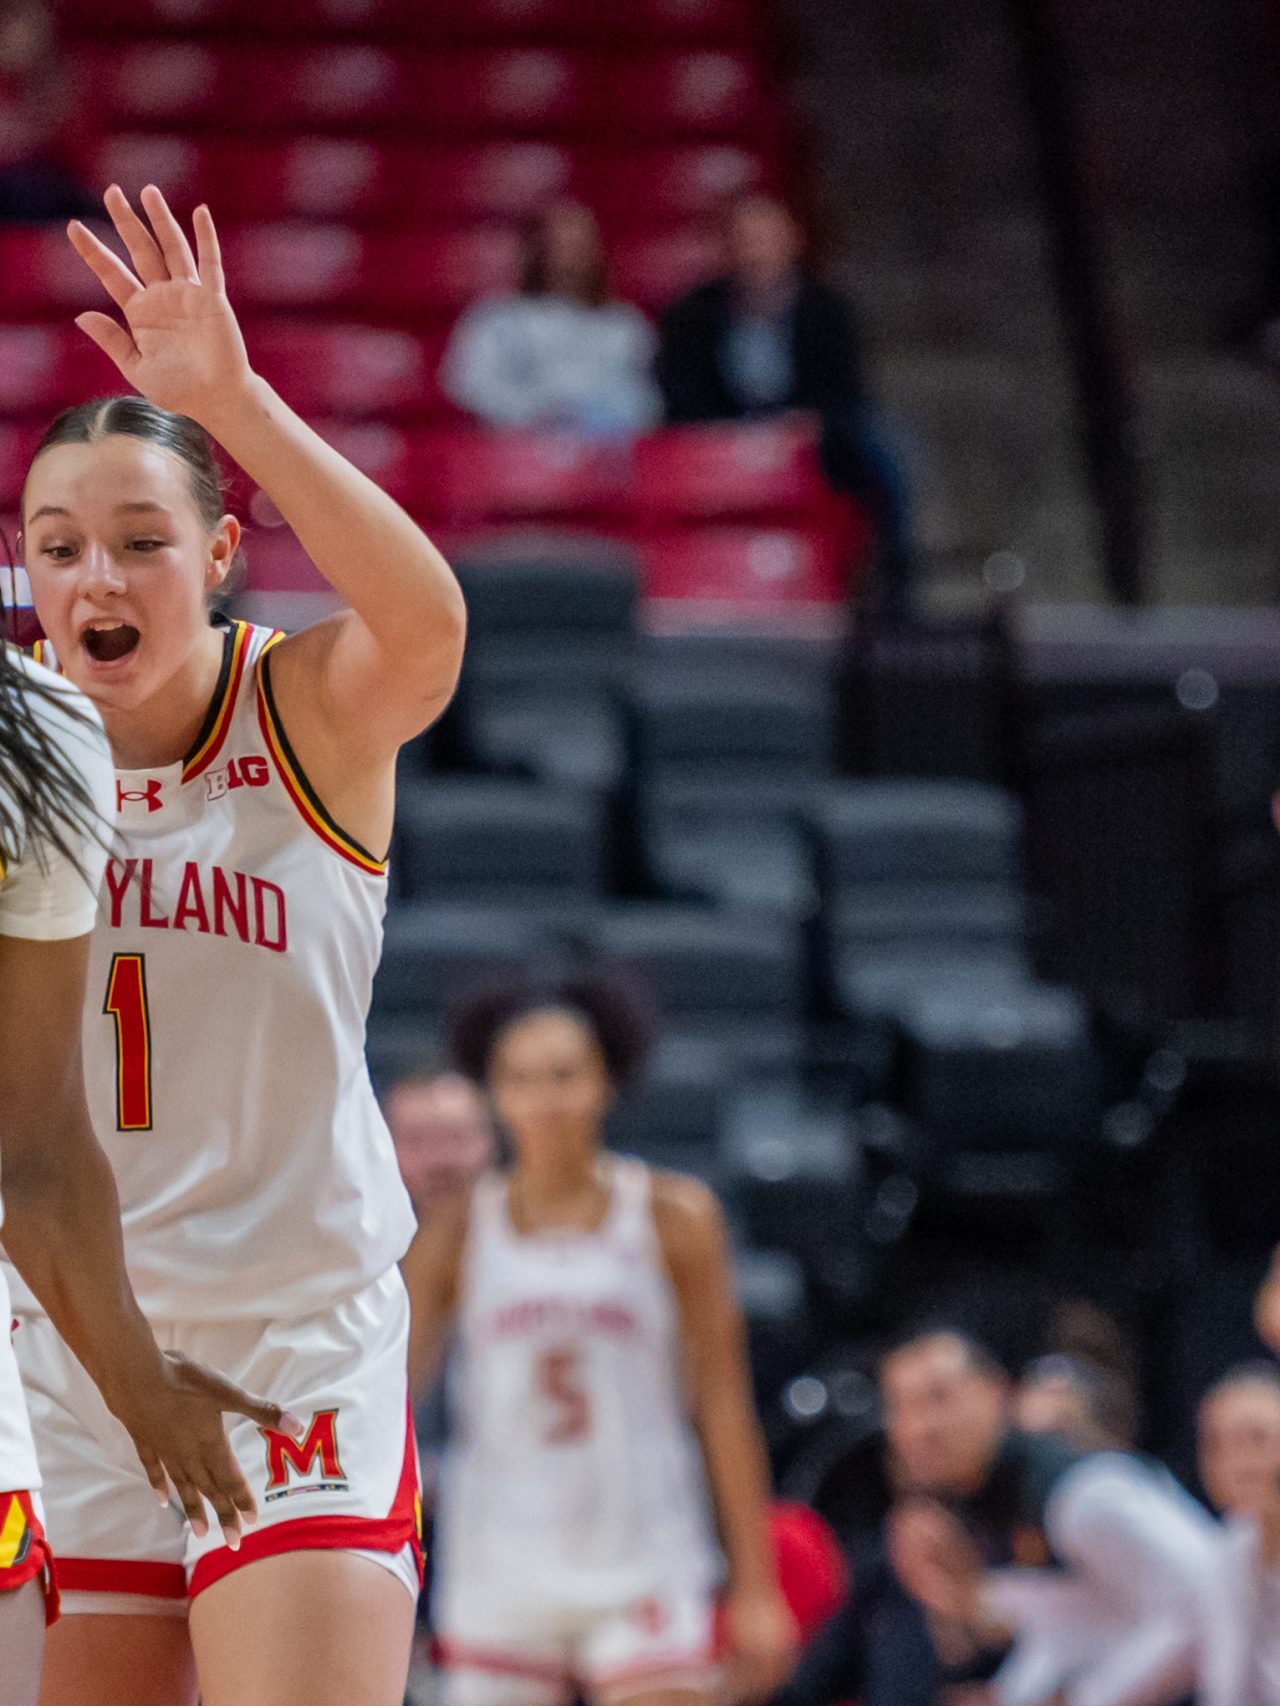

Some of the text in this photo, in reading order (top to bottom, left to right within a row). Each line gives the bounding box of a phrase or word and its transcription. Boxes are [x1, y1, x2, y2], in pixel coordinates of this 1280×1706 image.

[102, 952, 153, 1131] 1
[538, 1348, 593, 1447] 5
[260, 1408, 348, 1491] M
